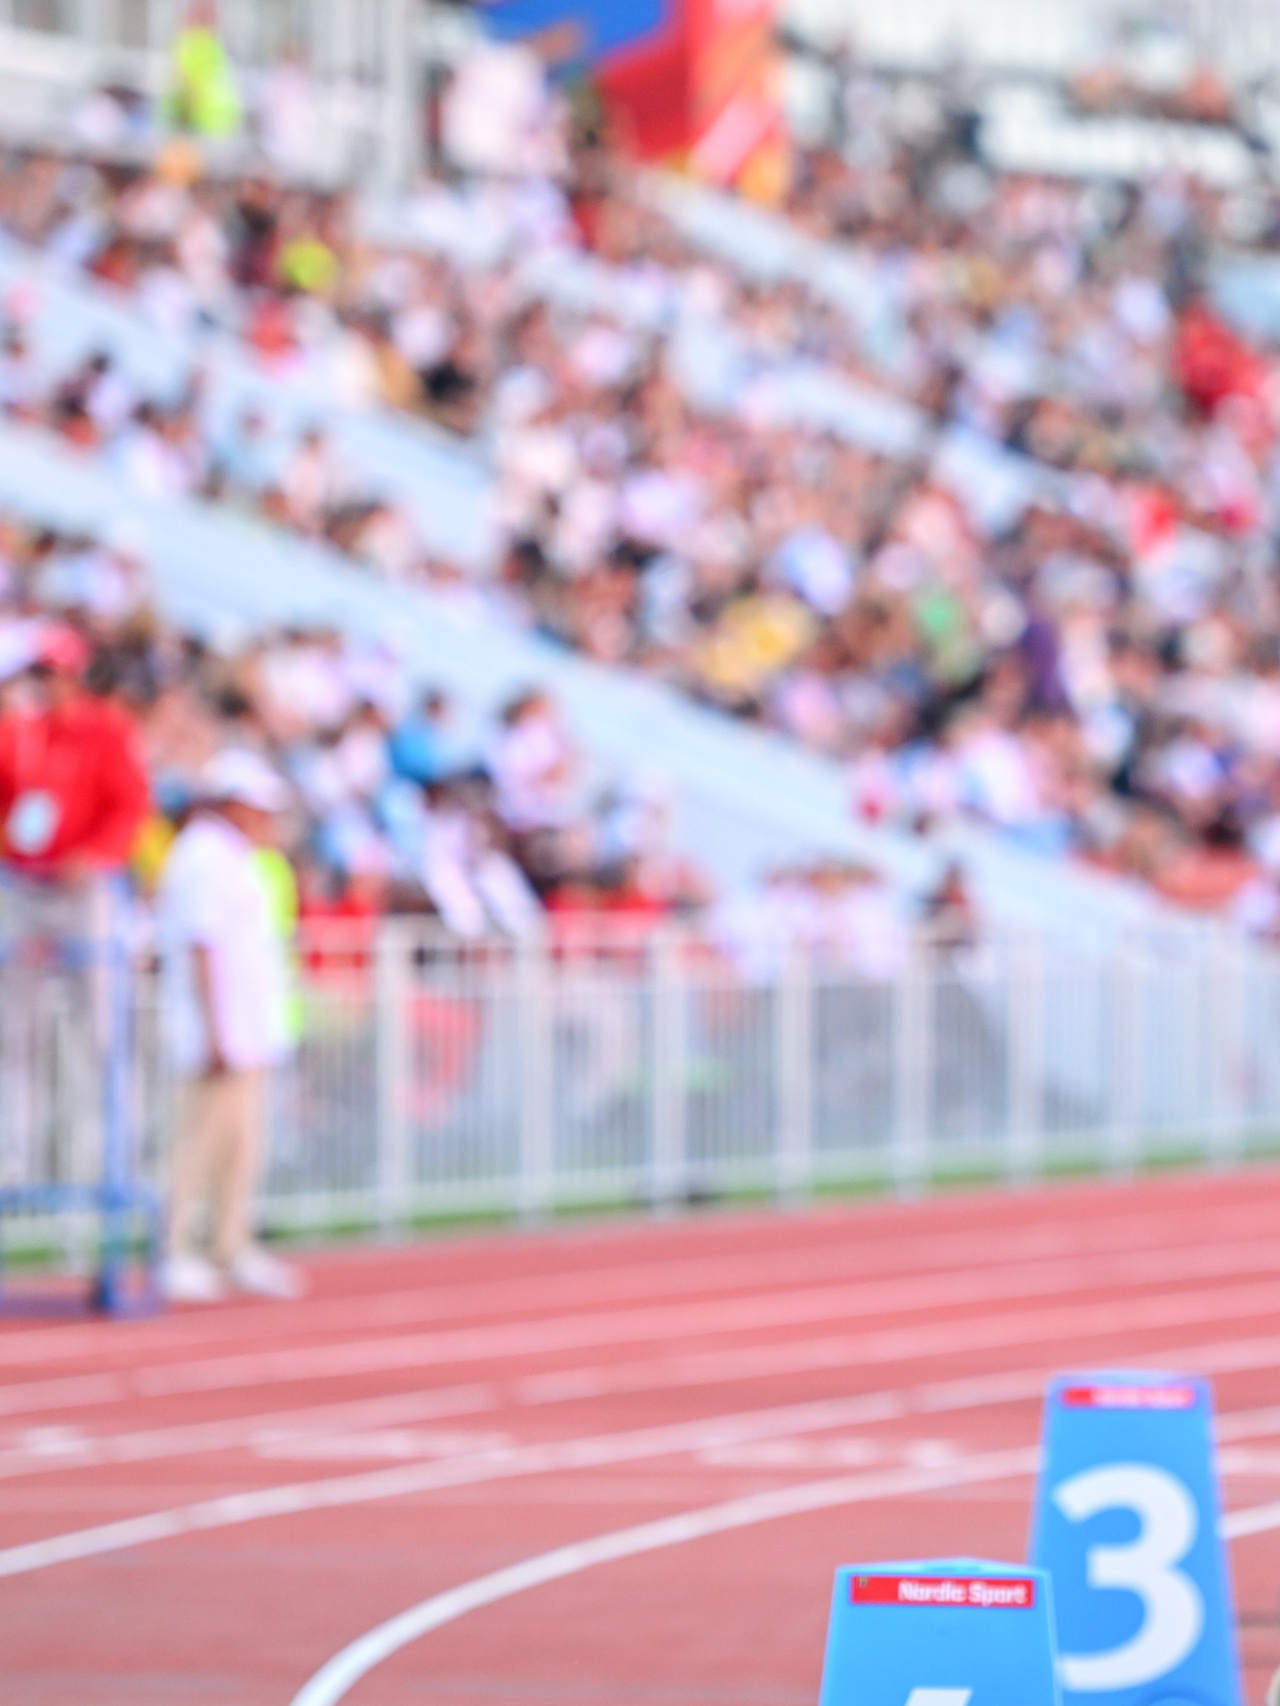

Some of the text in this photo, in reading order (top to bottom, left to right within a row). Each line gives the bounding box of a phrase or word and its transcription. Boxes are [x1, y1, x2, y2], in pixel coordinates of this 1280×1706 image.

[897, 1579, 1028, 1607] Nordic Sport
[1052, 1462, 1205, 1692] 3
